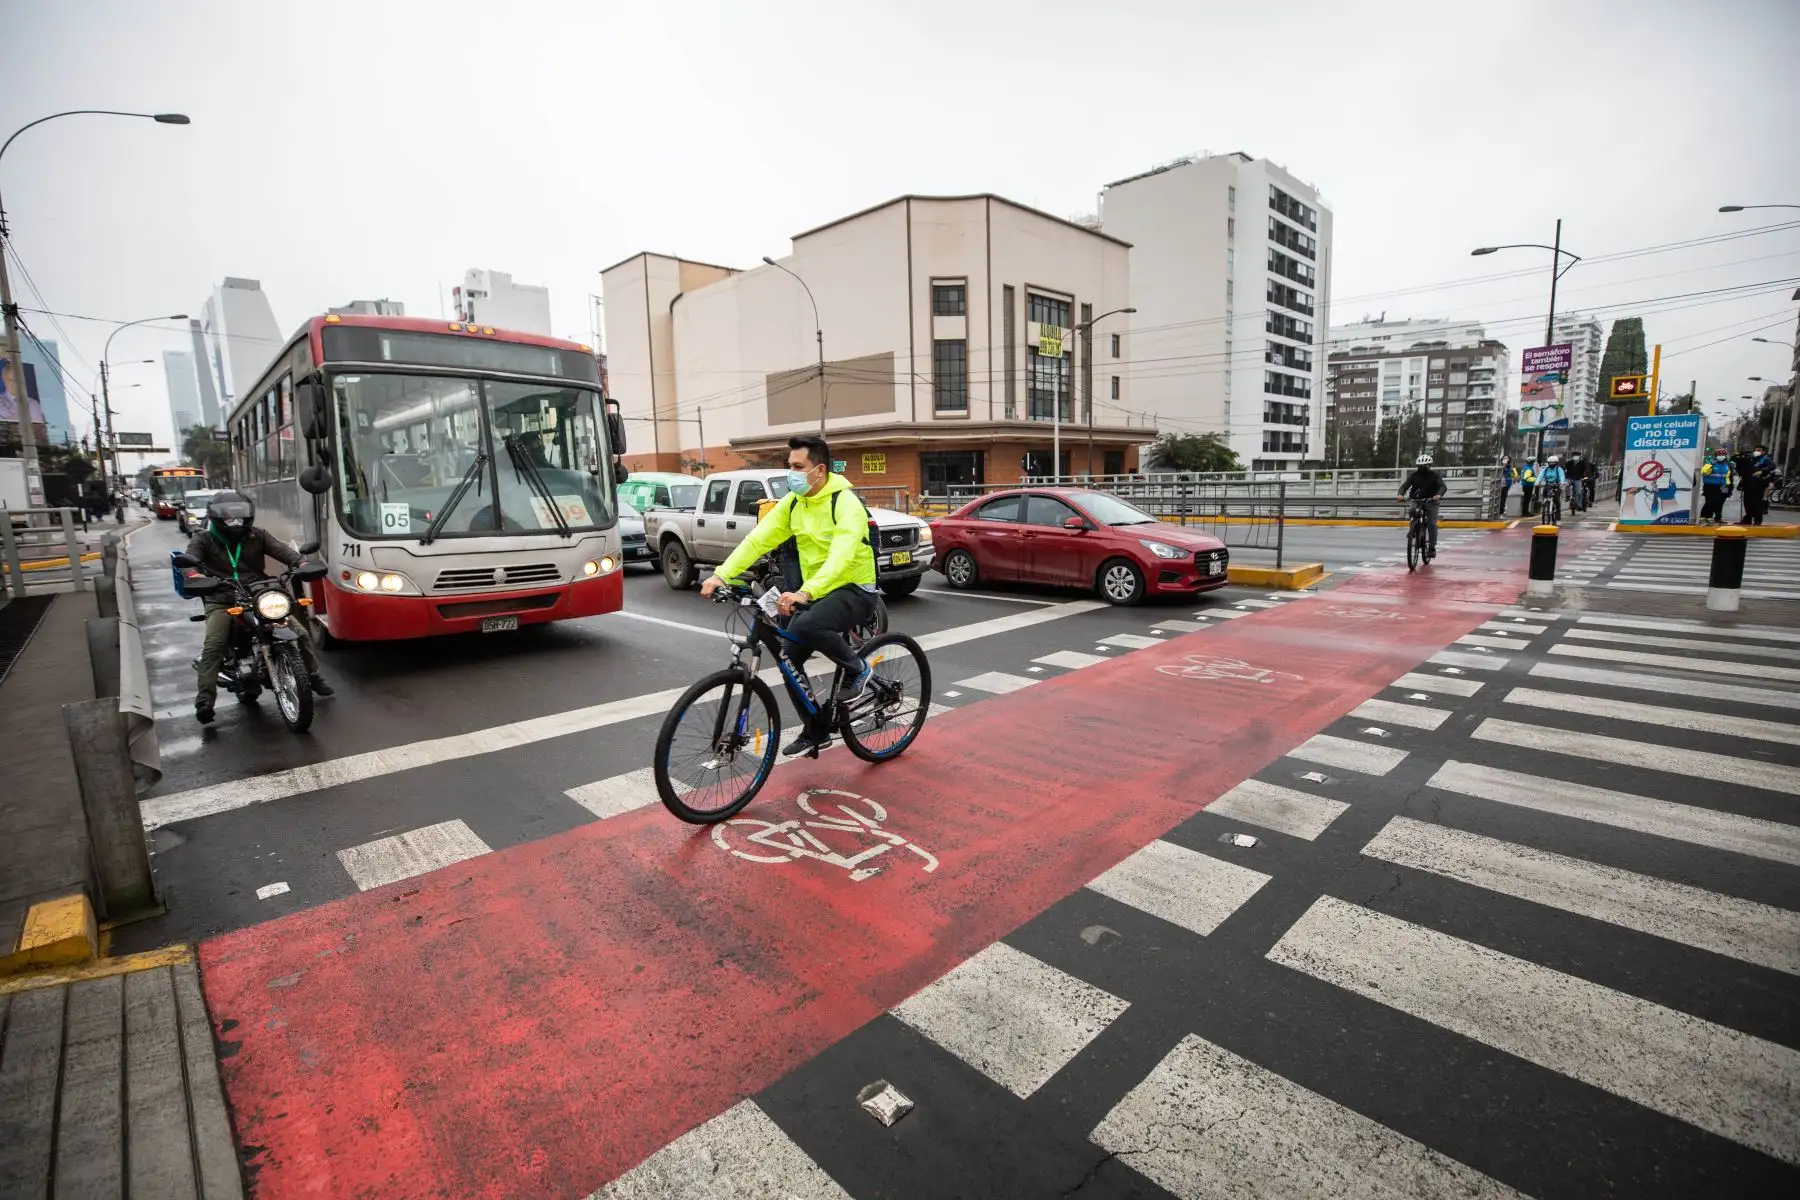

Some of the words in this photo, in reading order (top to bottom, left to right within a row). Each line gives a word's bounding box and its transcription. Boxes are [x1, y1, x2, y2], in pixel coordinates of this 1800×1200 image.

[1533, 348, 1570, 358] semáforo
[1531, 356, 1563, 364] también
[1537, 362, 1569, 371] respeta
[1631, 422, 1652, 430] Que
[1664, 420, 1697, 428] celular
[1633, 437, 1690, 447] distraiga
[384, 513, 408, 528] 05
[343, 543, 361, 557] 711
